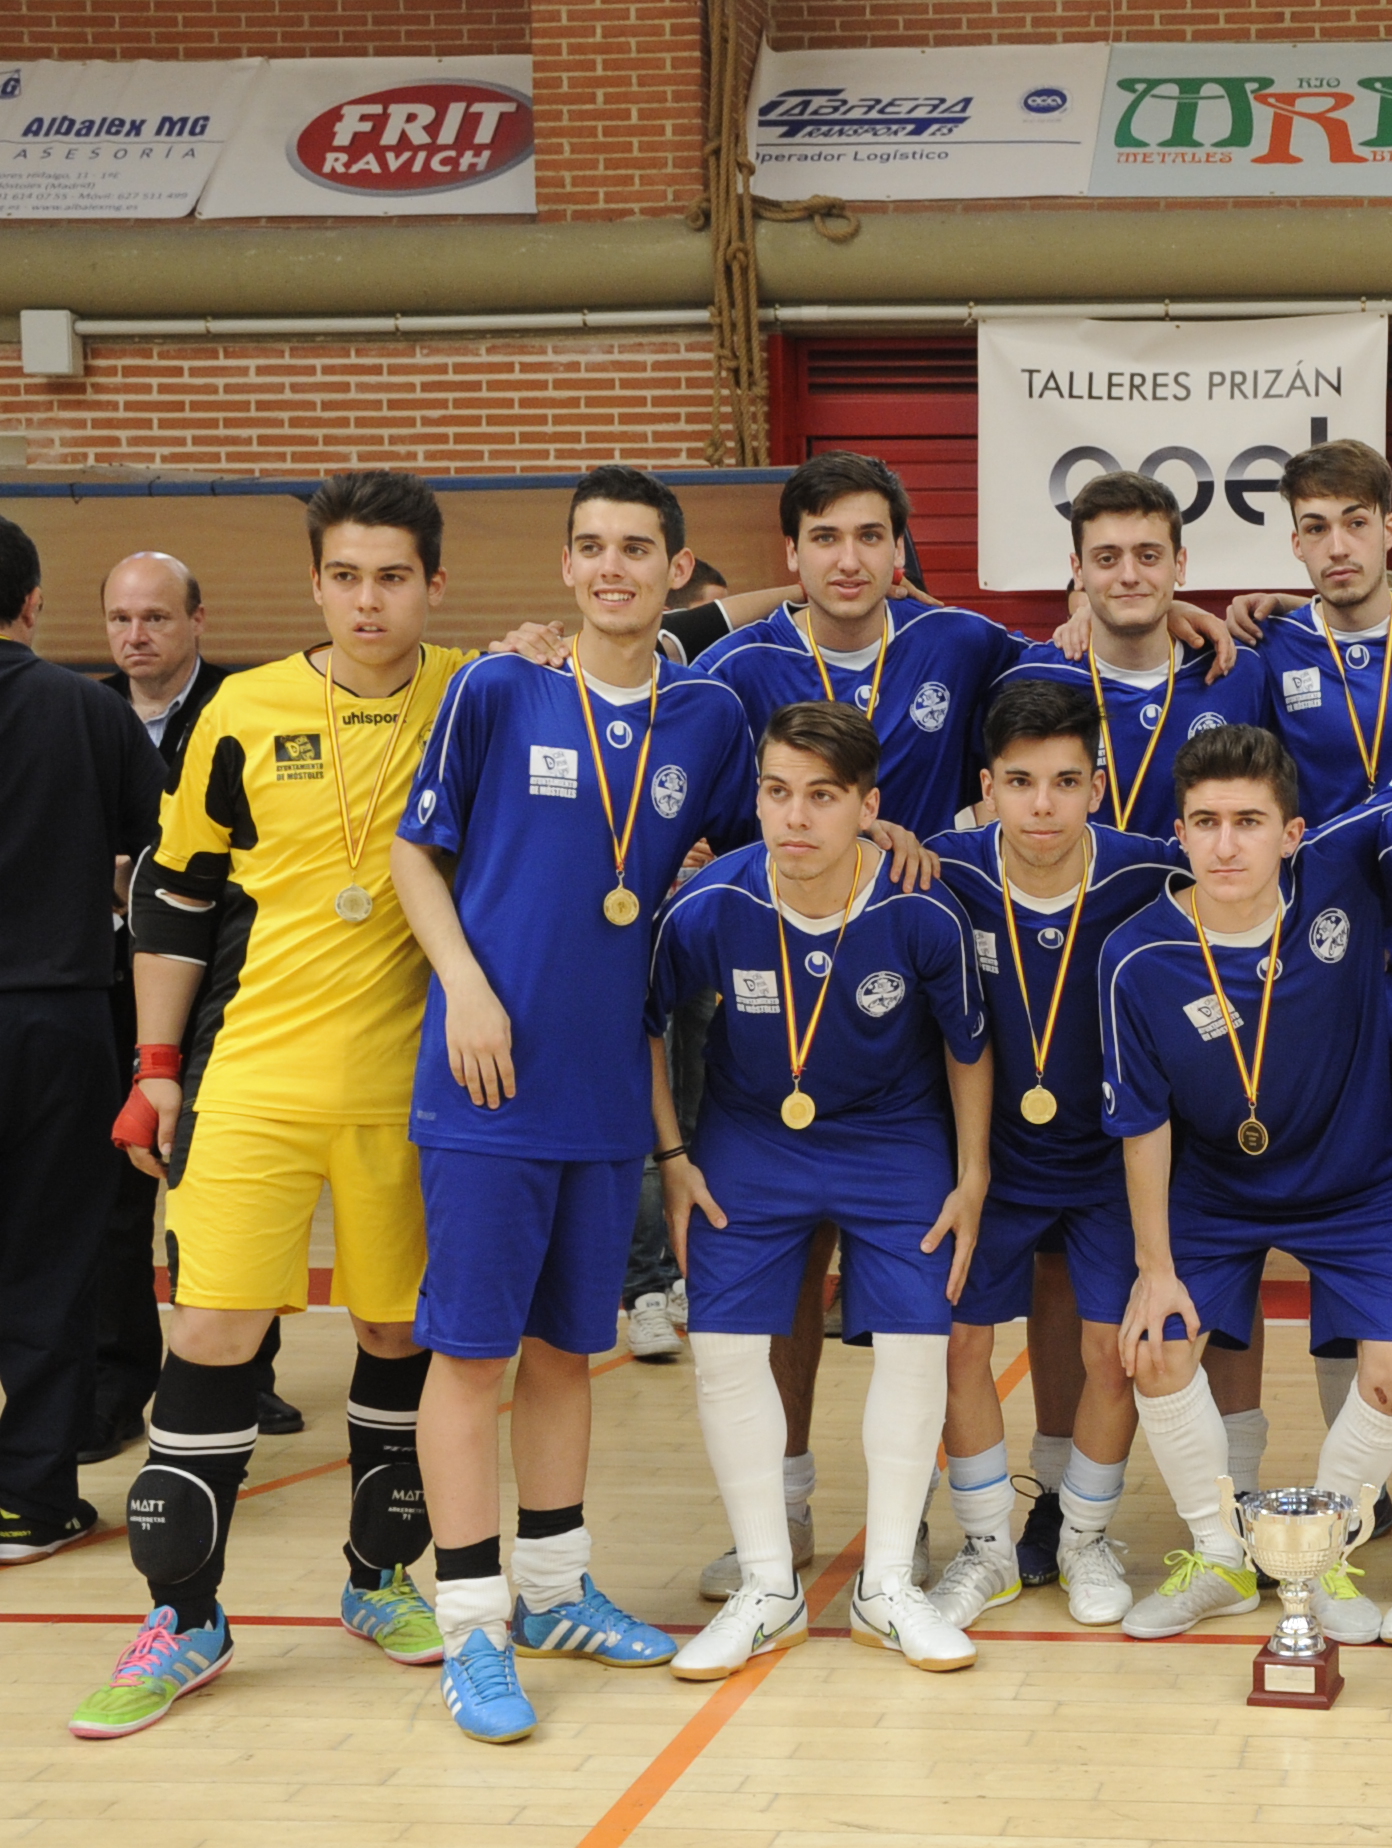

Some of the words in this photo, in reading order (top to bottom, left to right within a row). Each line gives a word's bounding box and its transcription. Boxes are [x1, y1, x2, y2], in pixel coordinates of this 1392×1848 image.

[1297, 77, 1341, 89] RIO
[21, 116, 147, 138] Albalex
[154, 115, 210, 137] MG
[332, 102, 517, 147] FRIT
[13, 146, 196, 160] ASESORÍA
[853, 149, 950, 164] Logístico
[1117, 151, 1233, 164] METALES
[322, 149, 491, 175] RAVICH
[1021, 368, 1192, 402] TALLERES
[1208, 360, 1342, 400] PRIZÁN
[342, 711, 407, 726] uhlspor
[131, 1499, 165, 1512] MATT
